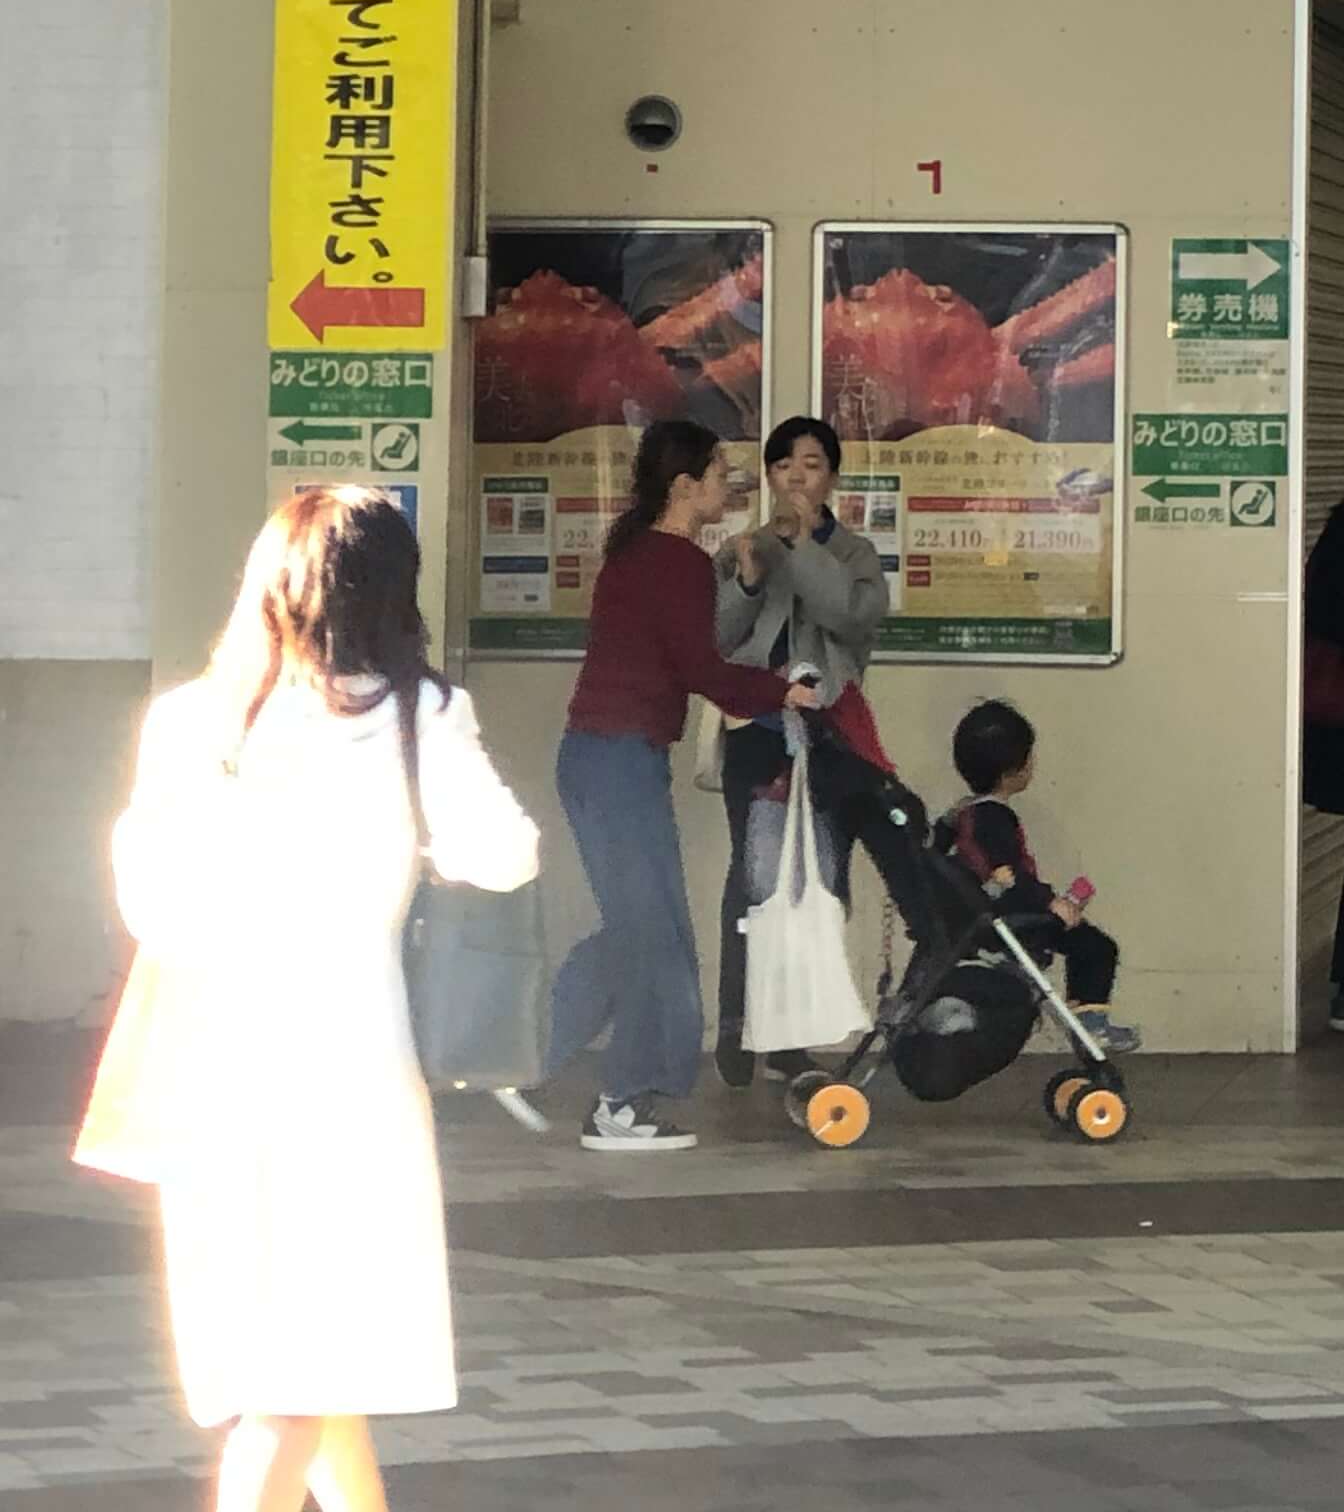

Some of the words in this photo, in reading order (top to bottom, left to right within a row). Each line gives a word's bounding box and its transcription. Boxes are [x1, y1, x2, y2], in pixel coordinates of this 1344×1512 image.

[1178, 292, 1280, 322] 券売機
[271, 358, 432, 388] みどりの窓口
[1134, 419, 1287, 447] みどりの窓口
